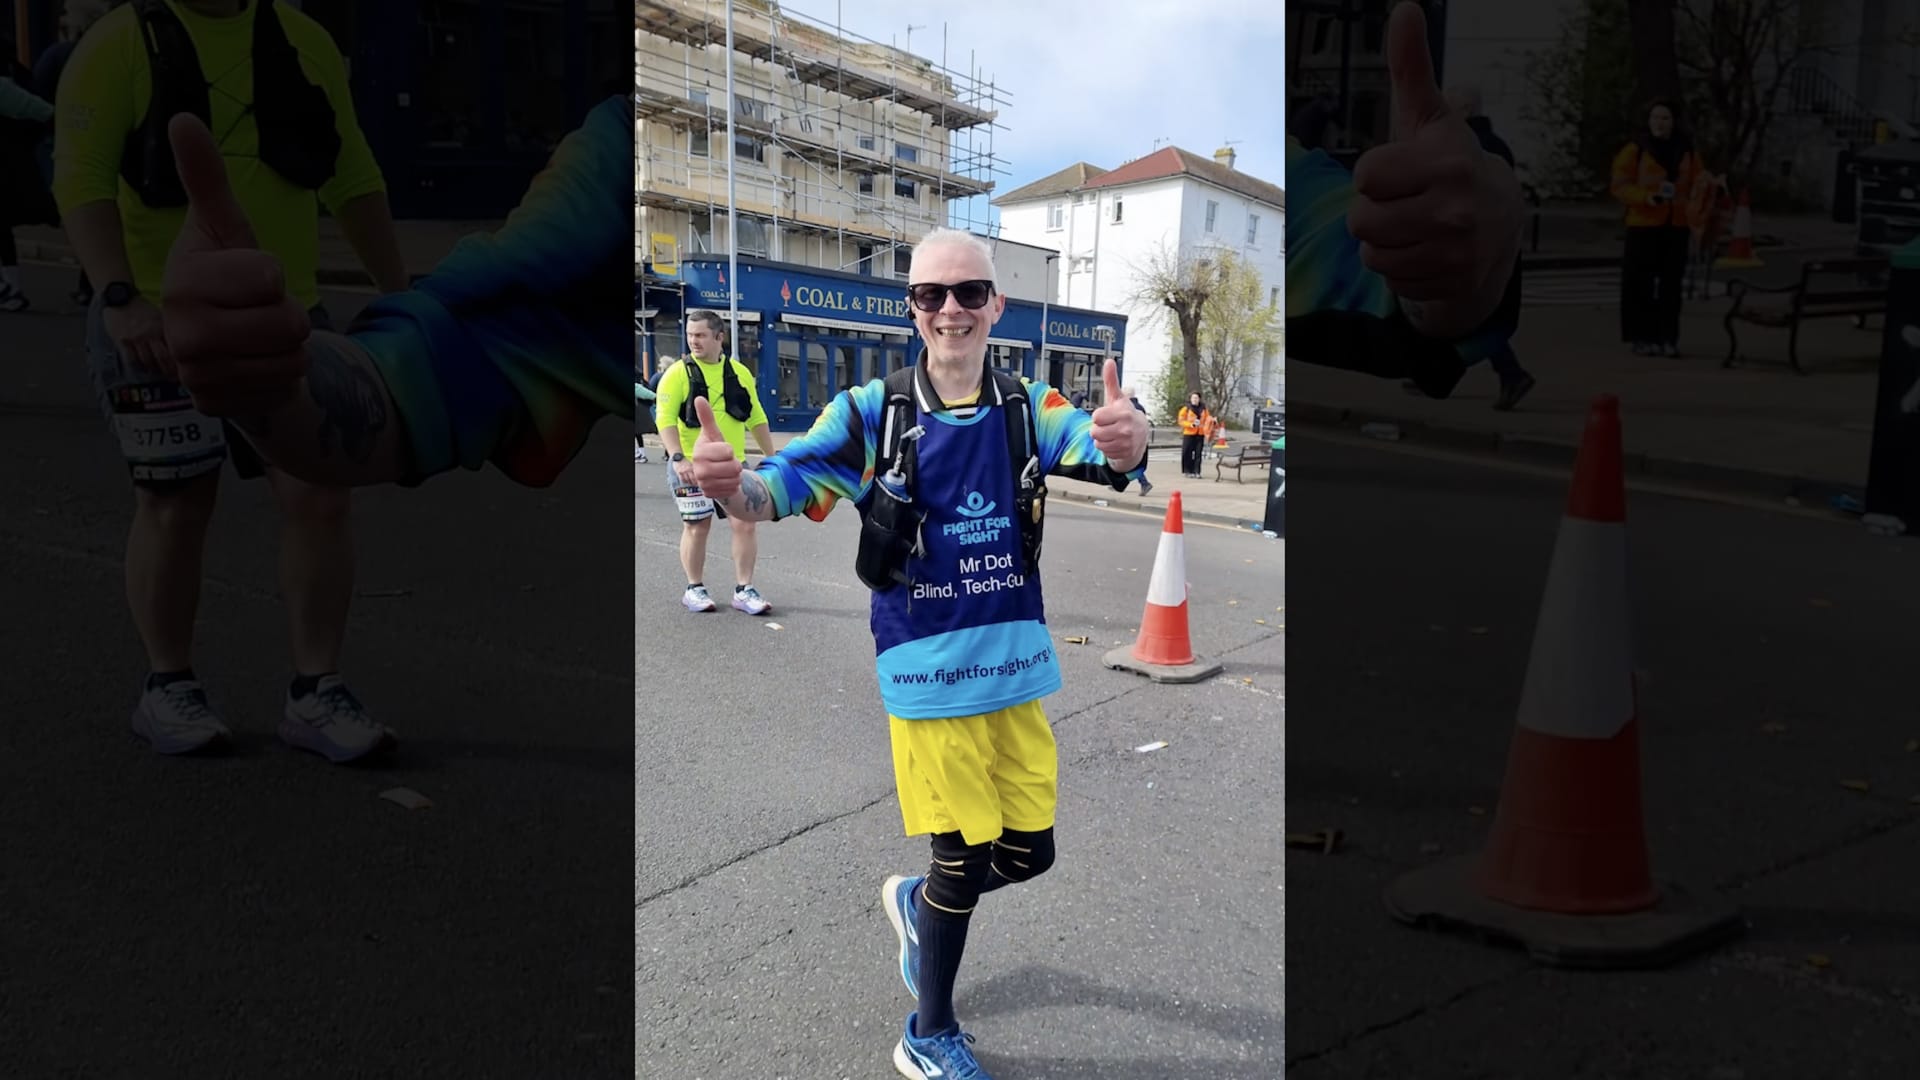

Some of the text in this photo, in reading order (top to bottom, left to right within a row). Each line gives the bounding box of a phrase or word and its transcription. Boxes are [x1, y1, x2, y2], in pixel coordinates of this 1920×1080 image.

[701, 290, 720, 298] COAL
[796, 286, 906, 318] COAL & FIRE
[1049, 321, 1080, 339] COAL
[1082, 327, 1089, 338] &
[943, 516, 1011, 536] FIGHT FOR
[959, 529, 1000, 545] SIGHT
[960, 553, 1013, 574] Mr Dot
[913, 582, 958, 599] Blind,
